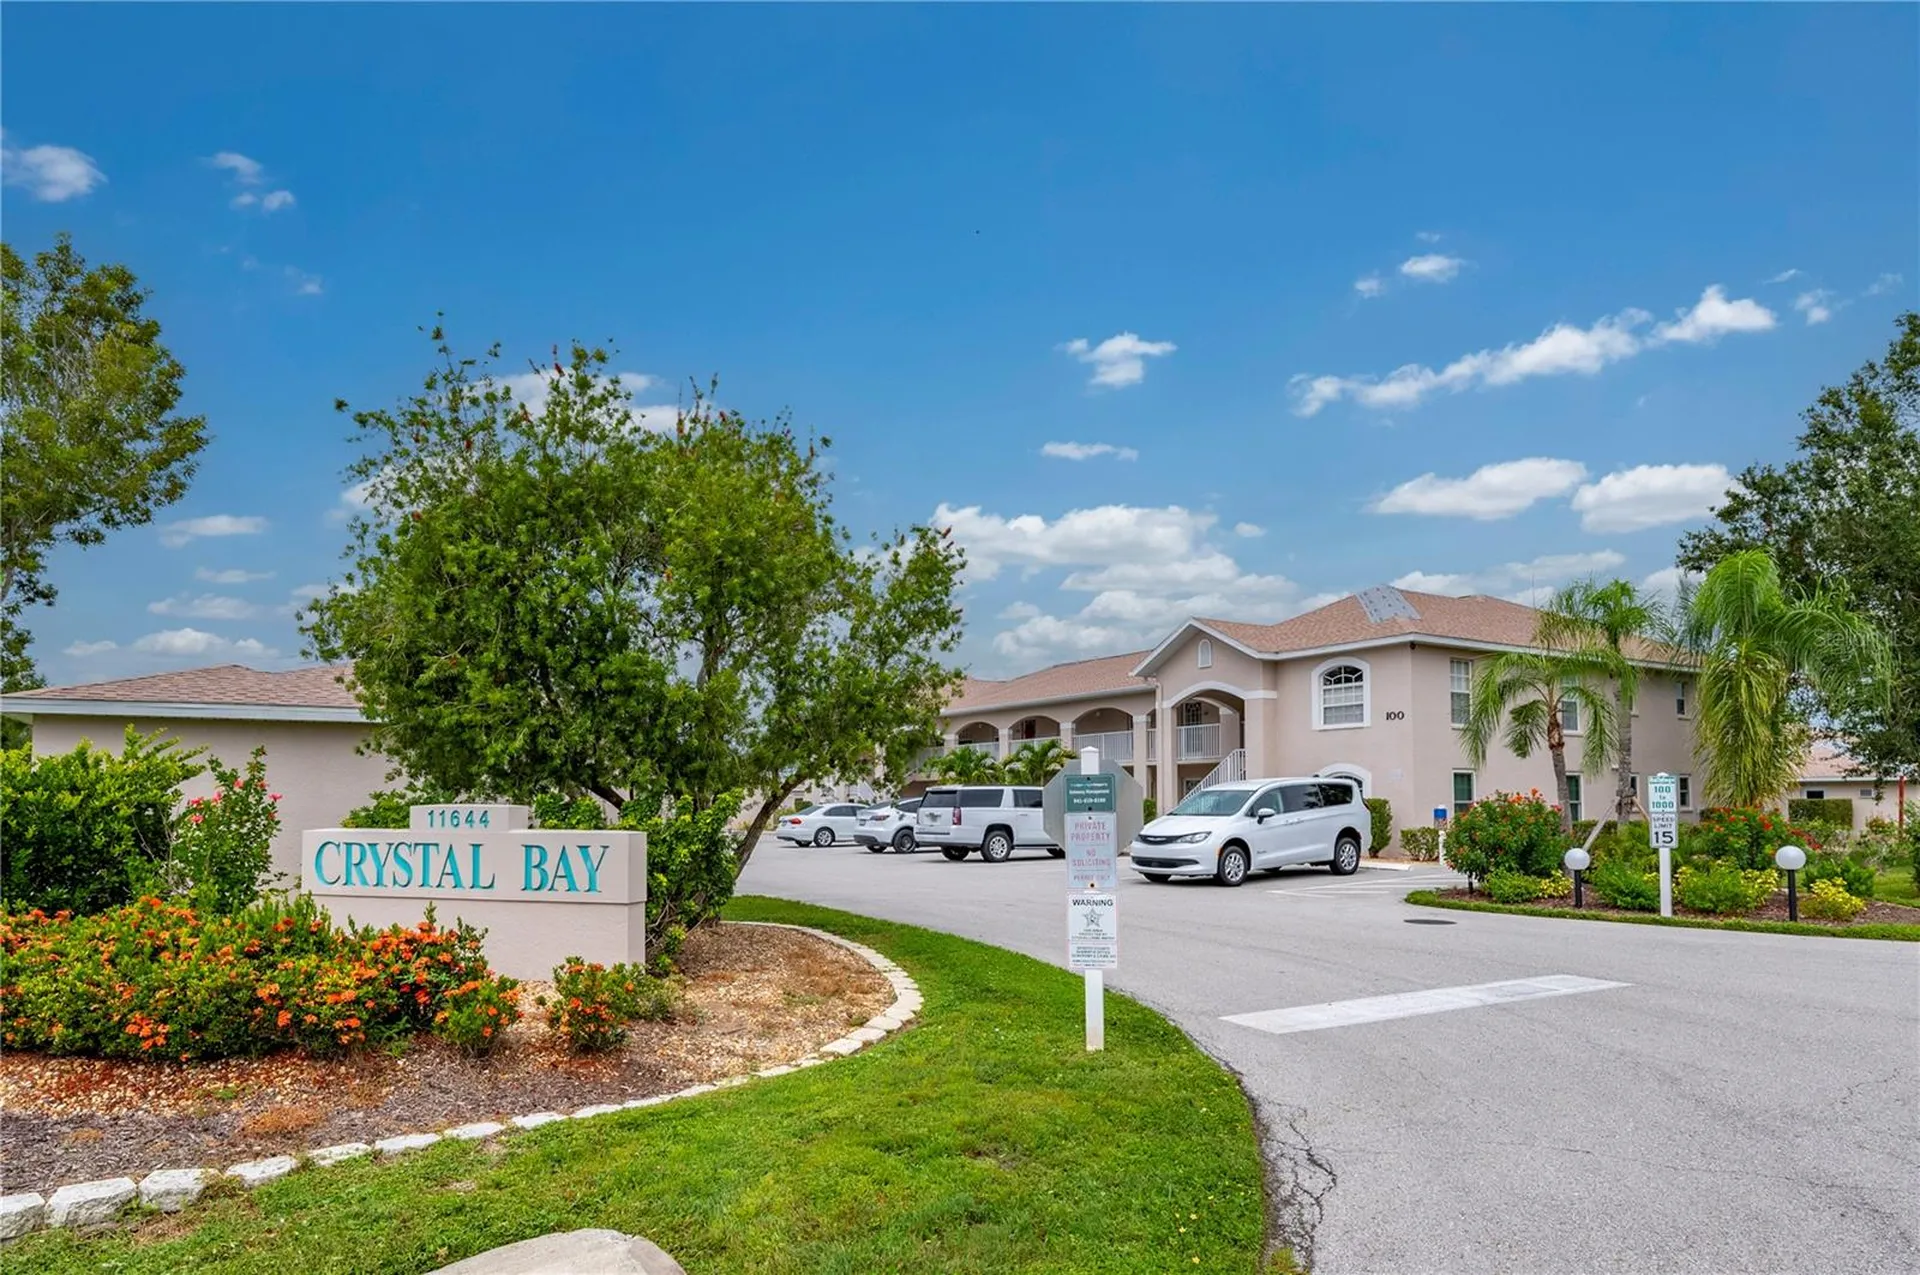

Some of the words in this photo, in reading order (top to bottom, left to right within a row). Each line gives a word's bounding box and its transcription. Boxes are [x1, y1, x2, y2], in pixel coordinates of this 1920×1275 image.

[1385, 710, 1405, 721] 100
[1652, 801, 1674, 809] 1000
[427, 809, 490, 828] 11644
[1074, 821, 1106, 831] PRIVATE
[1070, 832, 1110, 842] PROPERTY
[1654, 831, 1674, 844] 15
[314, 840, 496, 890] CRYSTAL
[520, 843, 611, 893] BAY
[1072, 899, 1114, 907] WARNING
